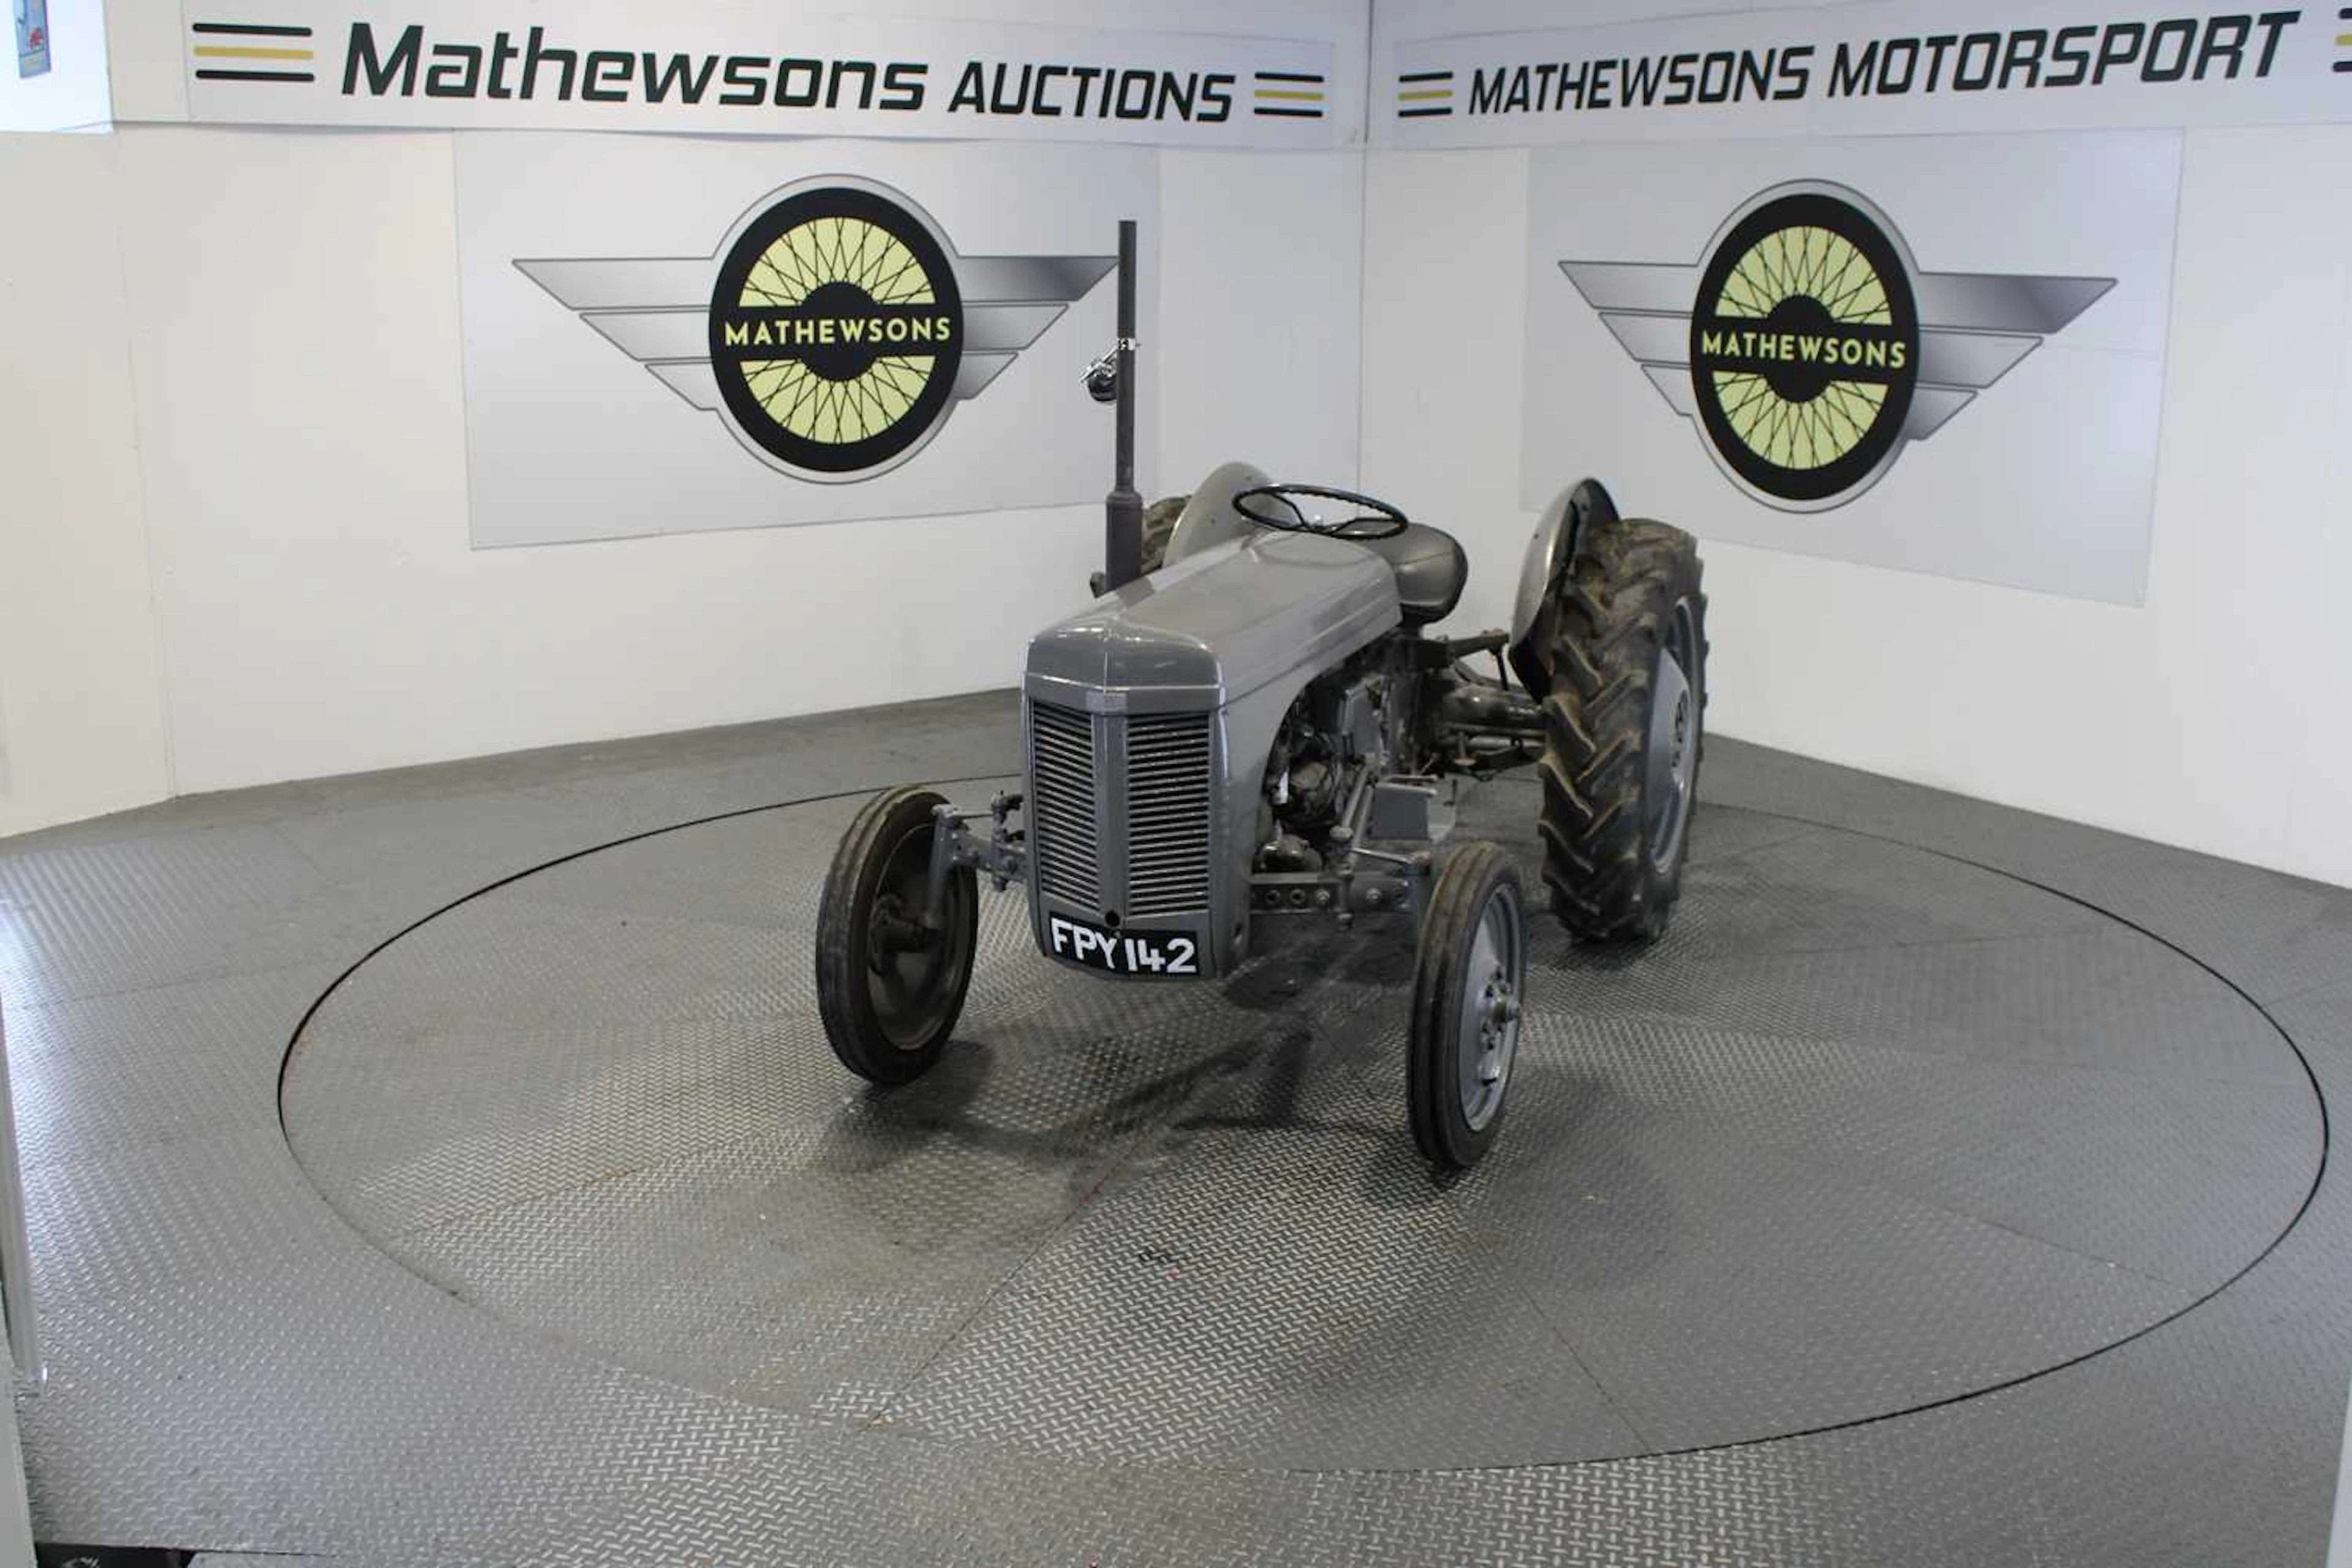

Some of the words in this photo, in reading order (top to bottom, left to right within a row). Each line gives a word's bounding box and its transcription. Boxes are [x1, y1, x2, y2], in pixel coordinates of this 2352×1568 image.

[342, 22, 929, 110] Mathewsons
[948, 61, 1236, 123] AUCTIONS
[1468, 45, 1815, 115] MATHEWSONS
[1827, 10, 2302, 98] MOTORSPORT
[724, 317, 951, 347] MATHEWSONS
[1702, 331, 1905, 368] MATHEWSONS
